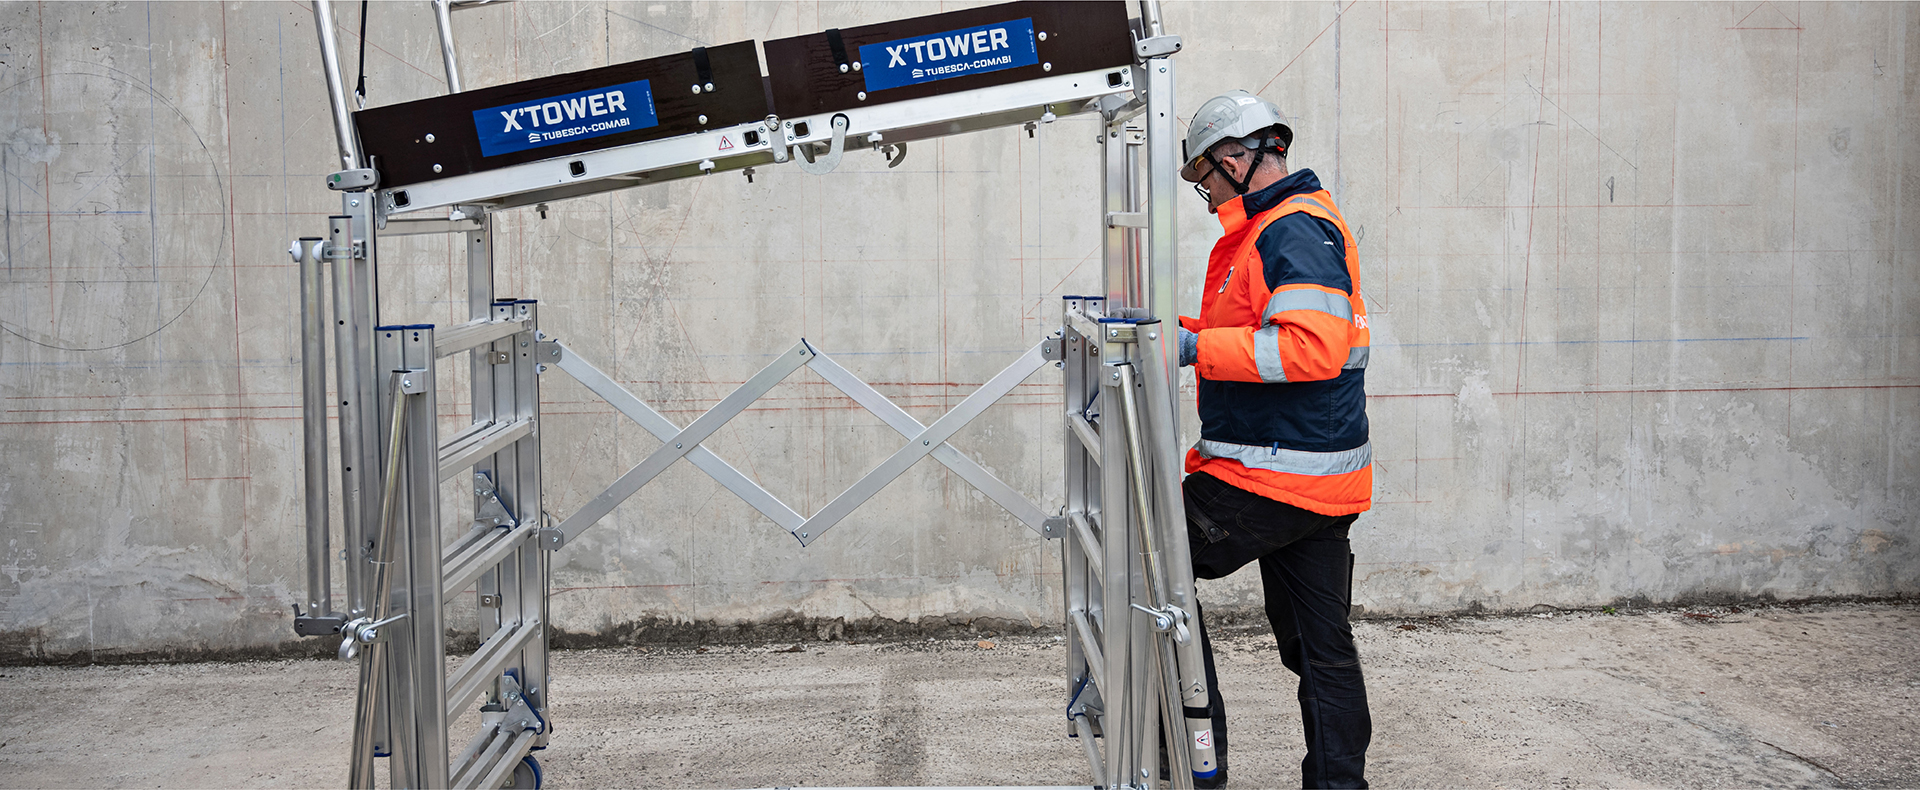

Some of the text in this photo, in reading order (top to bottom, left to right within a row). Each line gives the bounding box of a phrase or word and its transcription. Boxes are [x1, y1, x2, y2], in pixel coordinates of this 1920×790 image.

[886, 27, 1009, 68] X'TOWER
[925, 55, 1012, 76] TUBESCA-COMABI
[500, 90, 627, 133] X'TOWER
[542, 117, 630, 141] TUBESCA-COMABI
